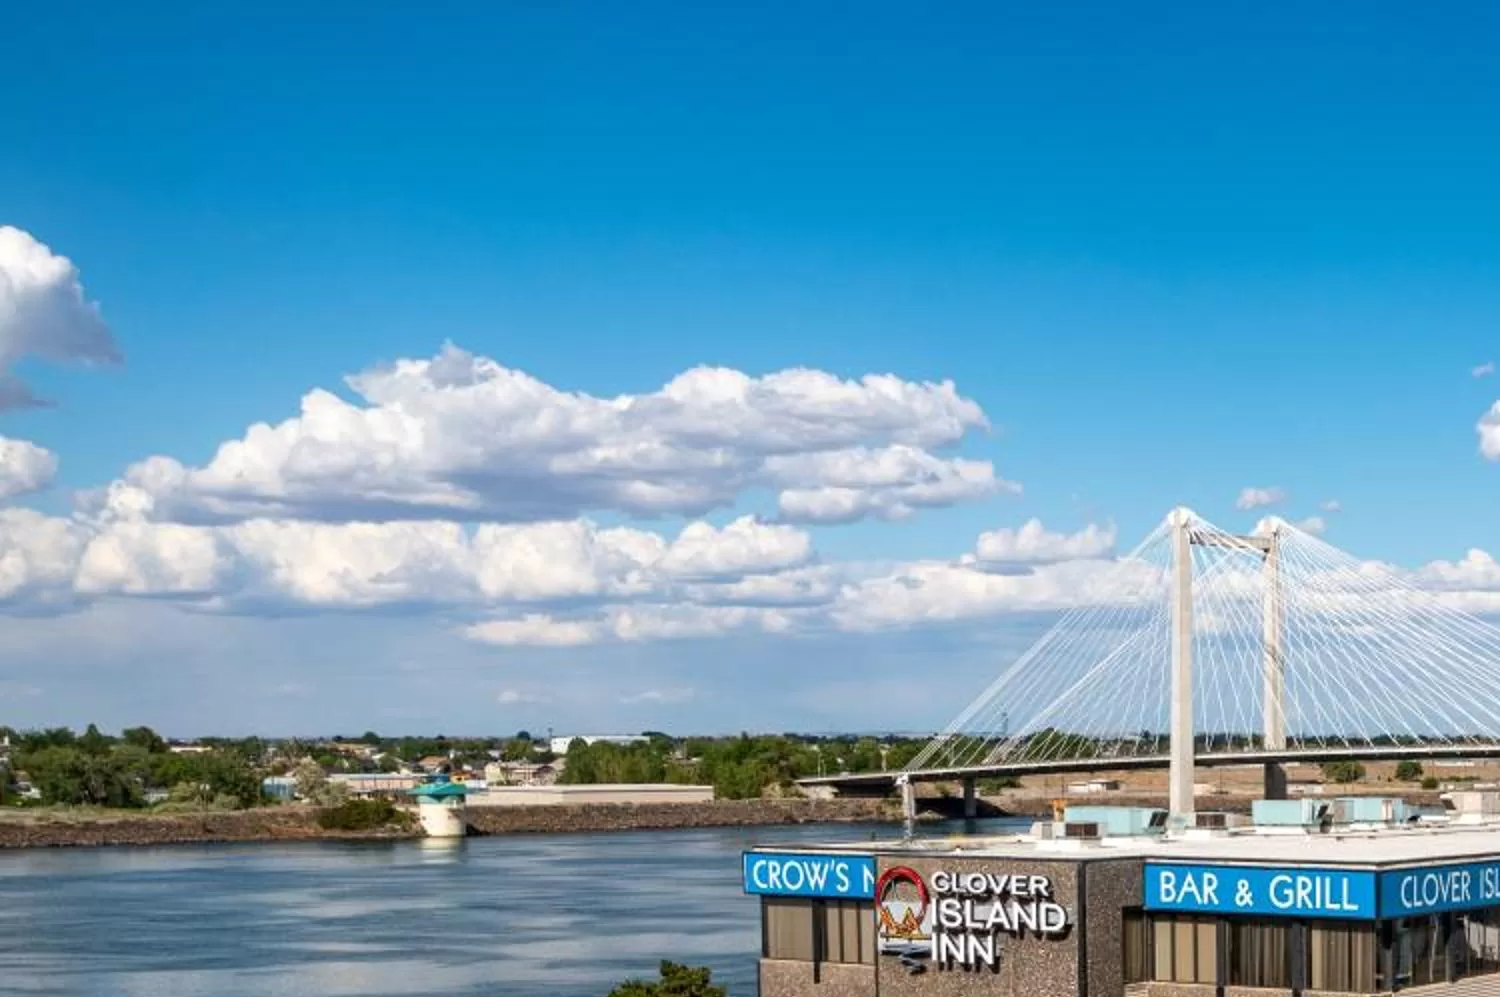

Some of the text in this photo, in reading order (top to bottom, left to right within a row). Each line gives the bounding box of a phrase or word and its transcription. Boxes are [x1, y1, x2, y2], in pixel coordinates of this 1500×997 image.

[752, 859, 849, 893] CROW'S
[930, 871, 1049, 897] CLOVER
[1159, 870, 1359, 911] BAR & GRILL
[1400, 869, 1471, 908] CLOVER
[931, 897, 1067, 932] ISLAND
[931, 932, 995, 964] INN
